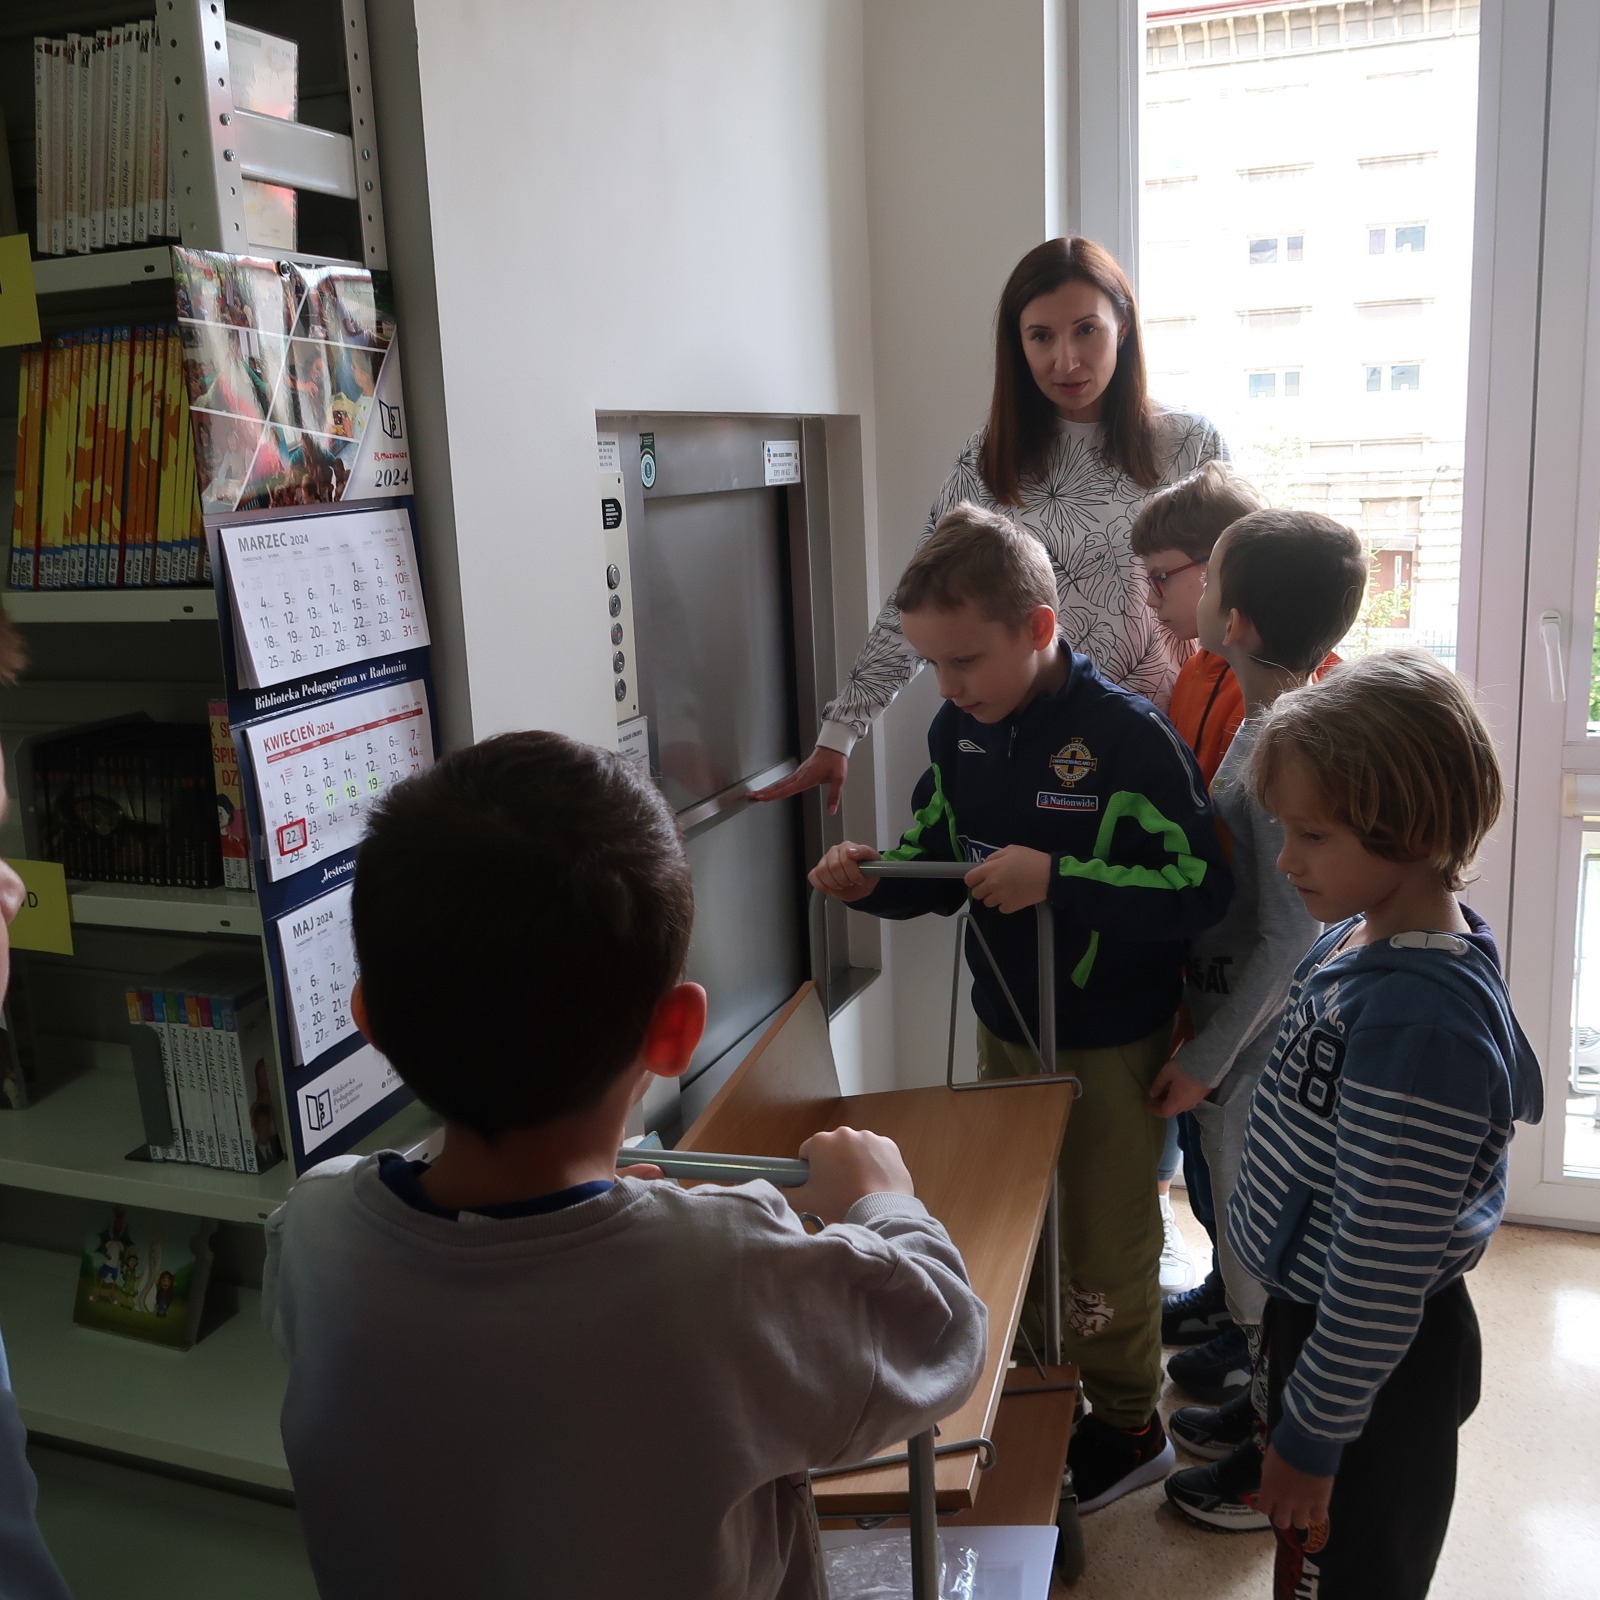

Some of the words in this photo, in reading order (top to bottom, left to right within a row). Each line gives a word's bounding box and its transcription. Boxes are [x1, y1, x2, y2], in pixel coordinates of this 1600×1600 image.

[374, 468, 408, 487] 2024
[238, 532, 288, 552] MARZEC
[290, 534, 309, 546] 2024
[352, 562, 356, 573] 1
[374, 558, 380, 570] 2
[395, 554, 402, 566] 3
[260, 596, 266, 608] 4
[284, 592, 290, 604] 5
[308, 588, 314, 600] 6
[330, 584, 336, 596] 7
[353, 580, 360, 592] 8
[377, 576, 382, 588] 9
[395, 572, 404, 584] 10
[260, 616, 270, 630] 11
[284, 611, 294, 624] 12
[307, 606, 317, 620] 13
[329, 602, 339, 615] 14
[352, 598, 362, 610] 15
[376, 594, 386, 606] 16
[398, 590, 406, 602] 17
[264, 636, 274, 649] 18
[288, 630, 298, 644] 19
[310, 626, 320, 638] 20
[332, 620, 342, 634] 21
[353, 616, 364, 629] 22
[378, 612, 388, 624] 23
[400, 608, 410, 620] 24
[268, 655, 279, 668] 25
[290, 650, 302, 664] 26
[314, 644, 324, 658] 27
[336, 639, 346, 652] 28
[356, 634, 366, 647] 29
[380, 630, 391, 642] 30
[402, 624, 412, 638] 31
[254, 688, 300, 711] Biblioteka
[301, 674, 358, 696] Pedagogiczna
[359, 672, 368, 682] w
[369, 660, 407, 678] Radomiu
[263, 721, 315, 752] KWIECIEŃ
[316, 722, 334, 735] 2024
[280, 774, 286, 786] 1
[303, 766, 308, 778] 2
[322, 758, 328, 770] 3
[344, 750, 350, 761] 4
[366, 742, 373, 754] 5
[389, 736, 394, 747] 6
[410, 729, 416, 740] 7
[284, 792, 290, 805] 8
[306, 784, 312, 796] 9
[322, 776, 332, 788] 10
[344, 768, 352, 780] 11
[366, 760, 376, 772] 12
[388, 753, 397, 765] 13
[409, 746, 418, 758] 14
[284, 811, 294, 824] 15
[306, 802, 315, 816] 16
[326, 794, 334, 808] 17
[346, 786, 356, 798] 18
[368, 778, 378, 790] 19
[390, 770, 400, 782] 20
[1050, 796, 1095, 808] Nationwide
[286, 830, 298, 844] 22
[308, 820, 318, 835] 23
[328, 812, 338, 826] 24
[348, 803, 360, 817] 25
[311, 838, 320, 854] 30
[292, 916, 314, 939] MAJ
[316, 910, 334, 926] 2024
[310, 974, 316, 987] 6
[330, 962, 336, 974] 7
[310, 993, 320, 1008] 13
[330, 981, 340, 994] 14
[312, 1011, 322, 1026] 20
[332, 998, 342, 1013] 21
[314, 1028, 324, 1044] 27
[335, 1015, 346, 1031] 28
